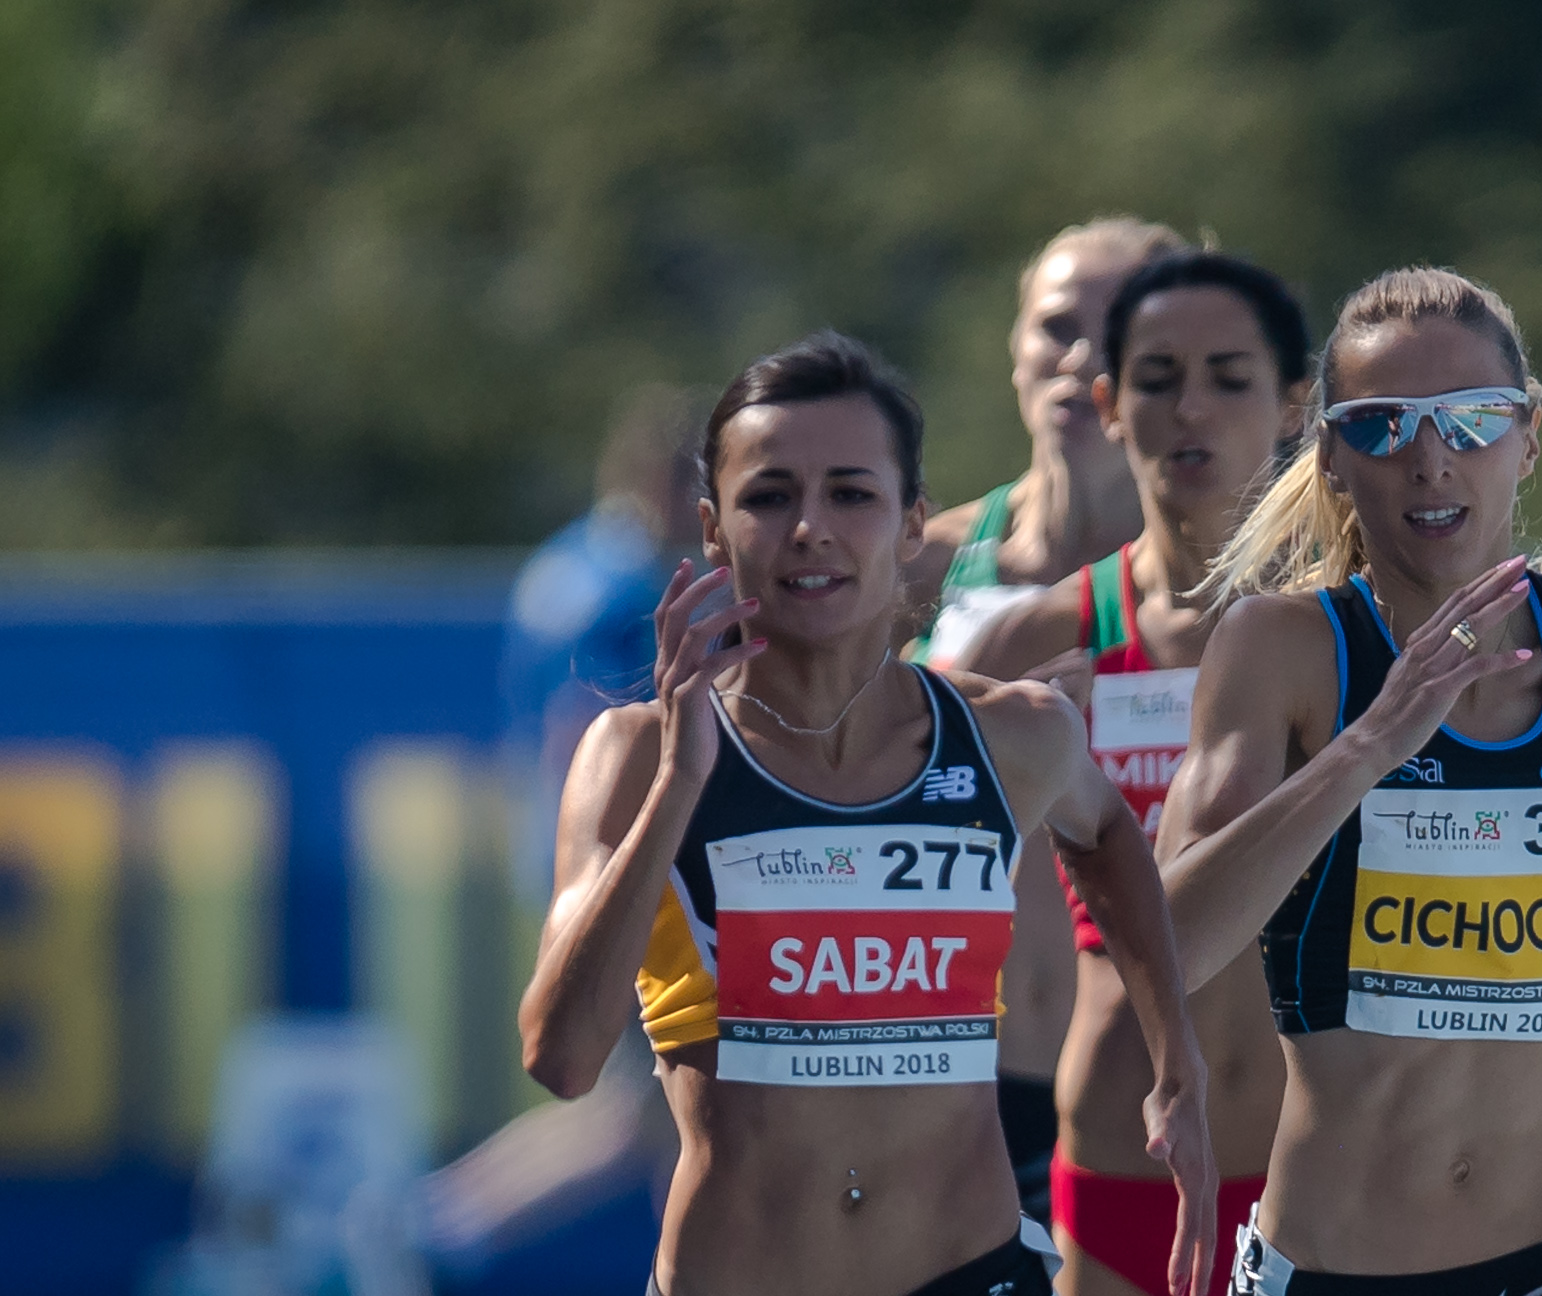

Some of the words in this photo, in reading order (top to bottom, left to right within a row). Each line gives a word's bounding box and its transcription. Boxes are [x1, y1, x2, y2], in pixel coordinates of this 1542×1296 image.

[878, 841, 997, 891] 277
[769, 936, 967, 994] SABAT
[1394, 979, 1442, 996] PZLA
[1417, 1009, 1508, 1032] LUBLIN
[765, 1026, 813, 1040] PZLA
[817, 1025, 944, 1041] MISTRZOSTWA
[791, 1055, 885, 1077] LUBLIN
[893, 1052, 951, 1076] 2018
